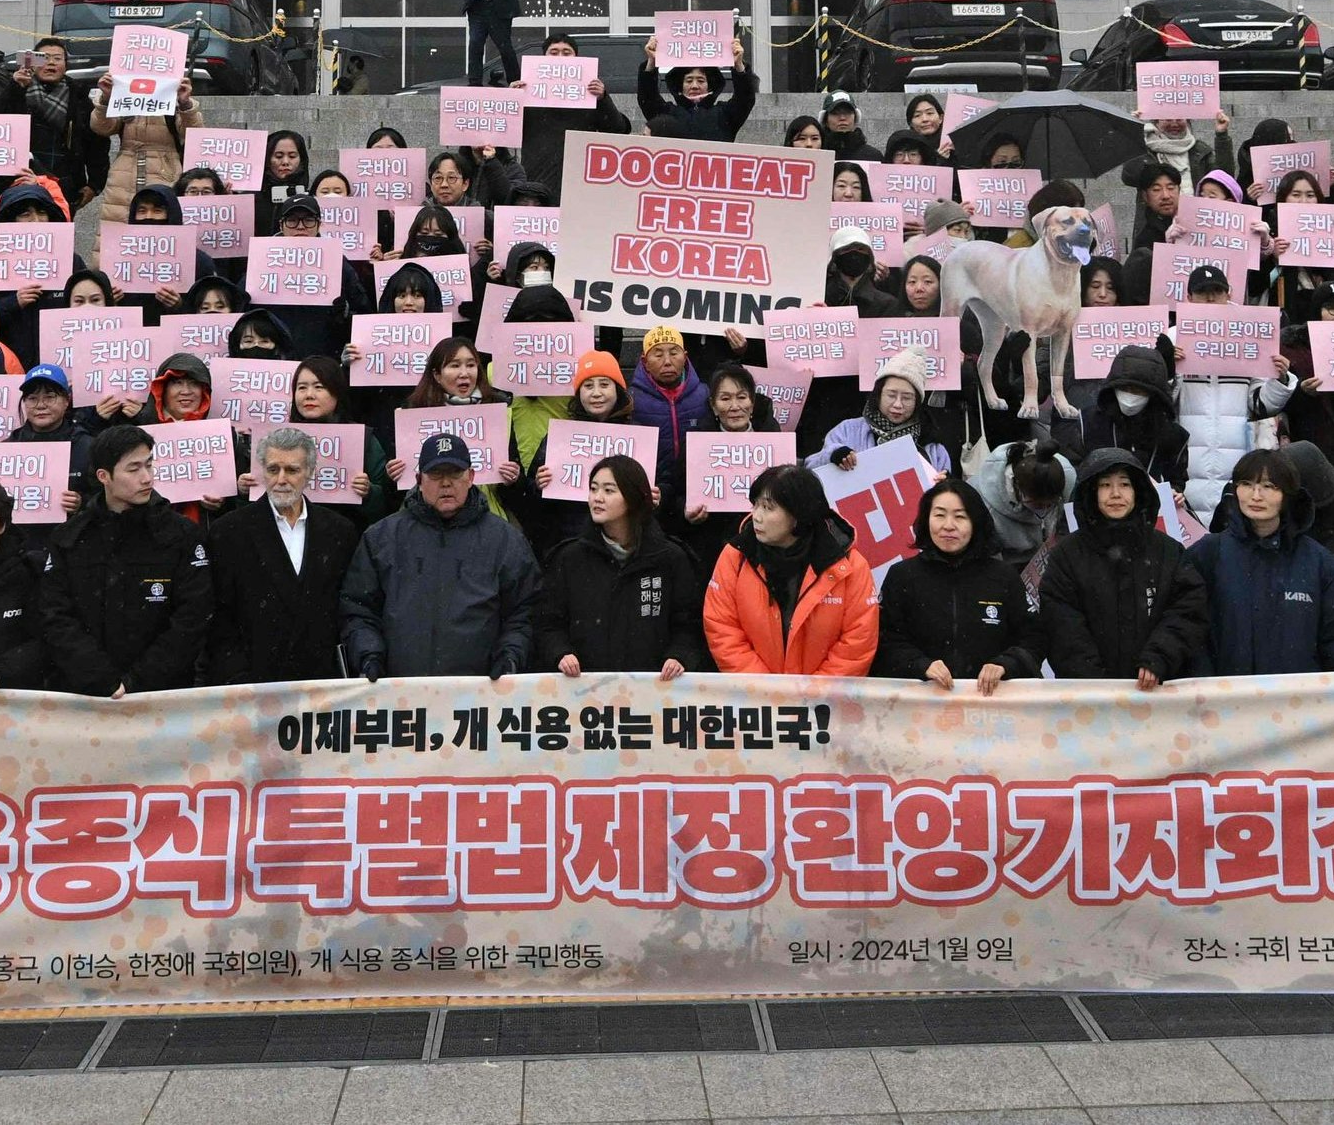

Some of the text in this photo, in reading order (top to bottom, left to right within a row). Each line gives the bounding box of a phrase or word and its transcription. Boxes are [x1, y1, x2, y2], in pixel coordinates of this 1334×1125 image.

[117, 7, 162, 16] 140호 9207
[978, 4, 1002, 14] 4268
[671, 20, 717, 37] 굿바이
[127, 33, 172, 52] 굿바이
[667, 42, 723, 58] 개 식용!
[119, 55, 175, 72] 개 식용!
[538, 64, 582, 80] 굿바이
[1141, 74, 1215, 88] 드디어 맞이한
[532, 85, 586, 101] 개 식용!
[1153, 91, 1204, 105] 우리의 봄
[113, 96, 174, 113] 바둑이쉼터
[443, 101, 519, 116] 드디어 맞이한
[454, 118, 507, 132] 우리의 봄
[200, 138, 248, 156] 굿바이
[357, 158, 407, 177] 굿바이
[1269, 152, 1315, 172] 굿바이
[585, 144, 815, 200] DOG MEAT
[352, 182, 412, 200] 개 식용!
[886, 175, 935, 194] 굿바이
[978, 178, 1026, 194] 굿바이
[182, 206, 236, 225] 굿바이
[637, 192, 754, 239] FREE
[975, 199, 991, 216] 개
[1196, 209, 1244, 231] 굿바이
[120, 235, 176, 256] 굿바이
[201, 229, 241, 247] 식용!
[1293, 237, 1310, 254] 개
[267, 247, 322, 268] 굿바이
[612, 235, 772, 286] KOREA
[14, 260, 58, 280] 식용!
[114, 262, 181, 283] 개 식용!
[259, 273, 327, 295] 개 식용!
[574, 280, 613, 313] IS
[371, 325, 430, 346] 굿바이
[768, 323, 856, 342] 드디어 맞이한
[1077, 322, 1164, 340] 드디어 맞이한
[1179, 320, 1274, 339] 드디어 맞이한
[515, 334, 573, 355] 굿바이
[880, 328, 938, 351] 굿바이
[91, 340, 150, 363] 굿바이
[785, 342, 844, 360] 우리의 봄
[1194, 343, 1259, 359] 우리의 봄
[366, 354, 384, 374] 개
[508, 363, 526, 384] 개
[85, 373, 102, 392] 개
[230, 370, 292, 394] 굿바이
[222, 400, 240, 421] 개
[178, 436, 227, 459] 맞이한
[570, 433, 634, 458] 굿바이
[709, 444, 773, 469] 굿바이
[196, 461, 213, 479] 봄
[561, 463, 582, 487] 개
[703, 475, 724, 499] 개
[1285, 591, 1314, 603] KARA
[278, 704, 831, 755] 이제부터, 개 식용 없는 대한민국!
[19, 782, 247, 921] 종식
[244, 775, 563, 915] 특별법
[561, 774, 783, 910] 제정
[779, 774, 1006, 909] 환영
[788, 937, 1014, 964] 일시 2024년 1월 9일
[1183, 937, 1228, 962] 장소
[1246, 936, 1289, 962] 국회
[50, 953, 121, 982] 이헌승,
[128, 951, 195, 978] 한정애
[201, 949, 303, 977] 국회의원),
[309, 949, 333, 973] 개
[339, 947, 384, 973] 식용
[390, 946, 458, 972] 종식을
[464, 945, 509, 971] 위한
[515, 944, 604, 969] 국민행동
